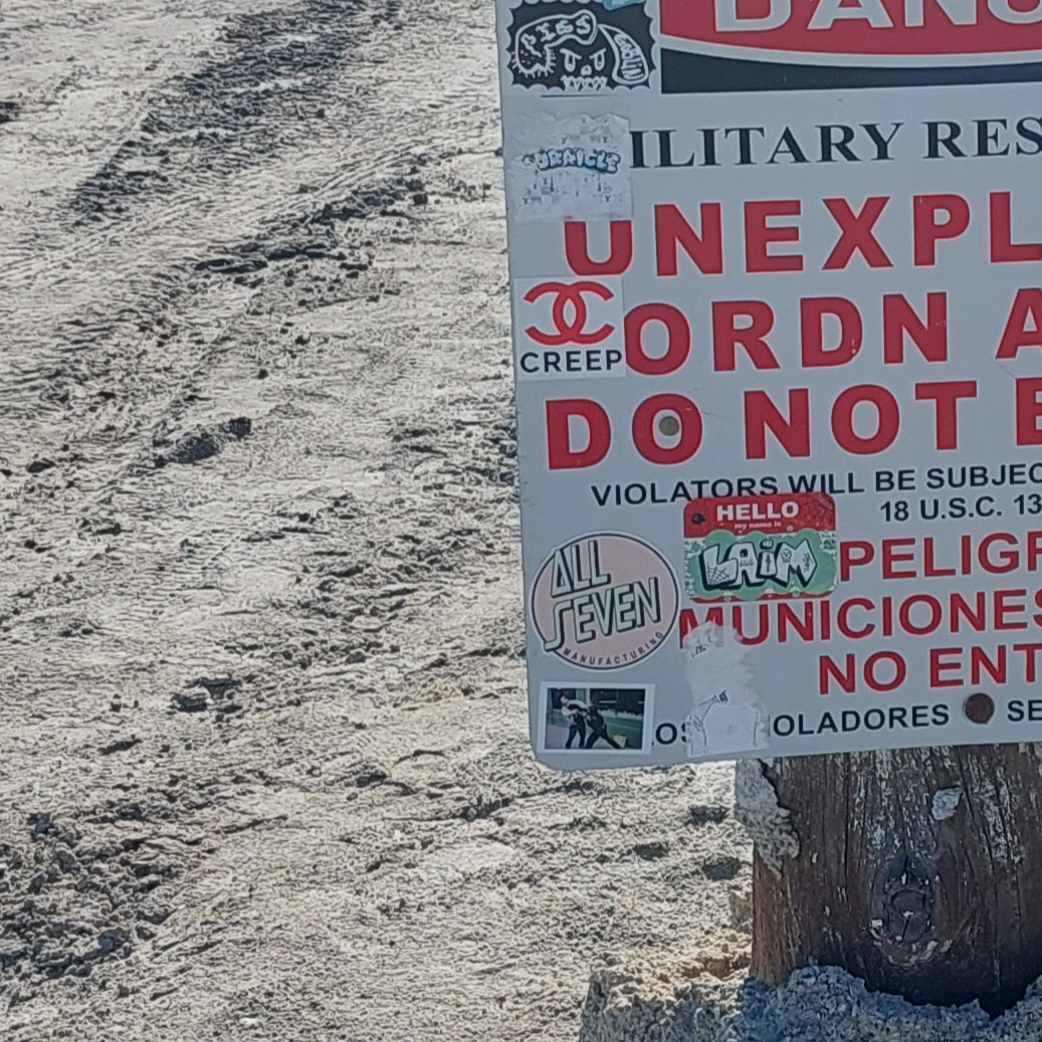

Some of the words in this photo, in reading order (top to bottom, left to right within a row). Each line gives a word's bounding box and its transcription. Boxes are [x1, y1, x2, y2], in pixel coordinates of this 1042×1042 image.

[629, 121, 905, 169] ILITARY
[520, 349, 622, 373] CREEP
[545, 393, 703, 470] DO
[744, 380, 977, 460] NOT
[591, 476, 779, 506] VIOLATORS
[788, 472, 865, 495] WILL
[875, 469, 918, 493] BE
[716, 501, 799, 521] HELLO
[880, 500, 909, 521] 18
[919, 495, 1003, 520] U.S.C.
[734, 523, 747, 531] my
[551, 540, 612, 599] ALL
[544, 577, 662, 652] SEVEN
[563, 631, 664, 666] MANUFACTURING
[820, 651, 907, 695] NO
